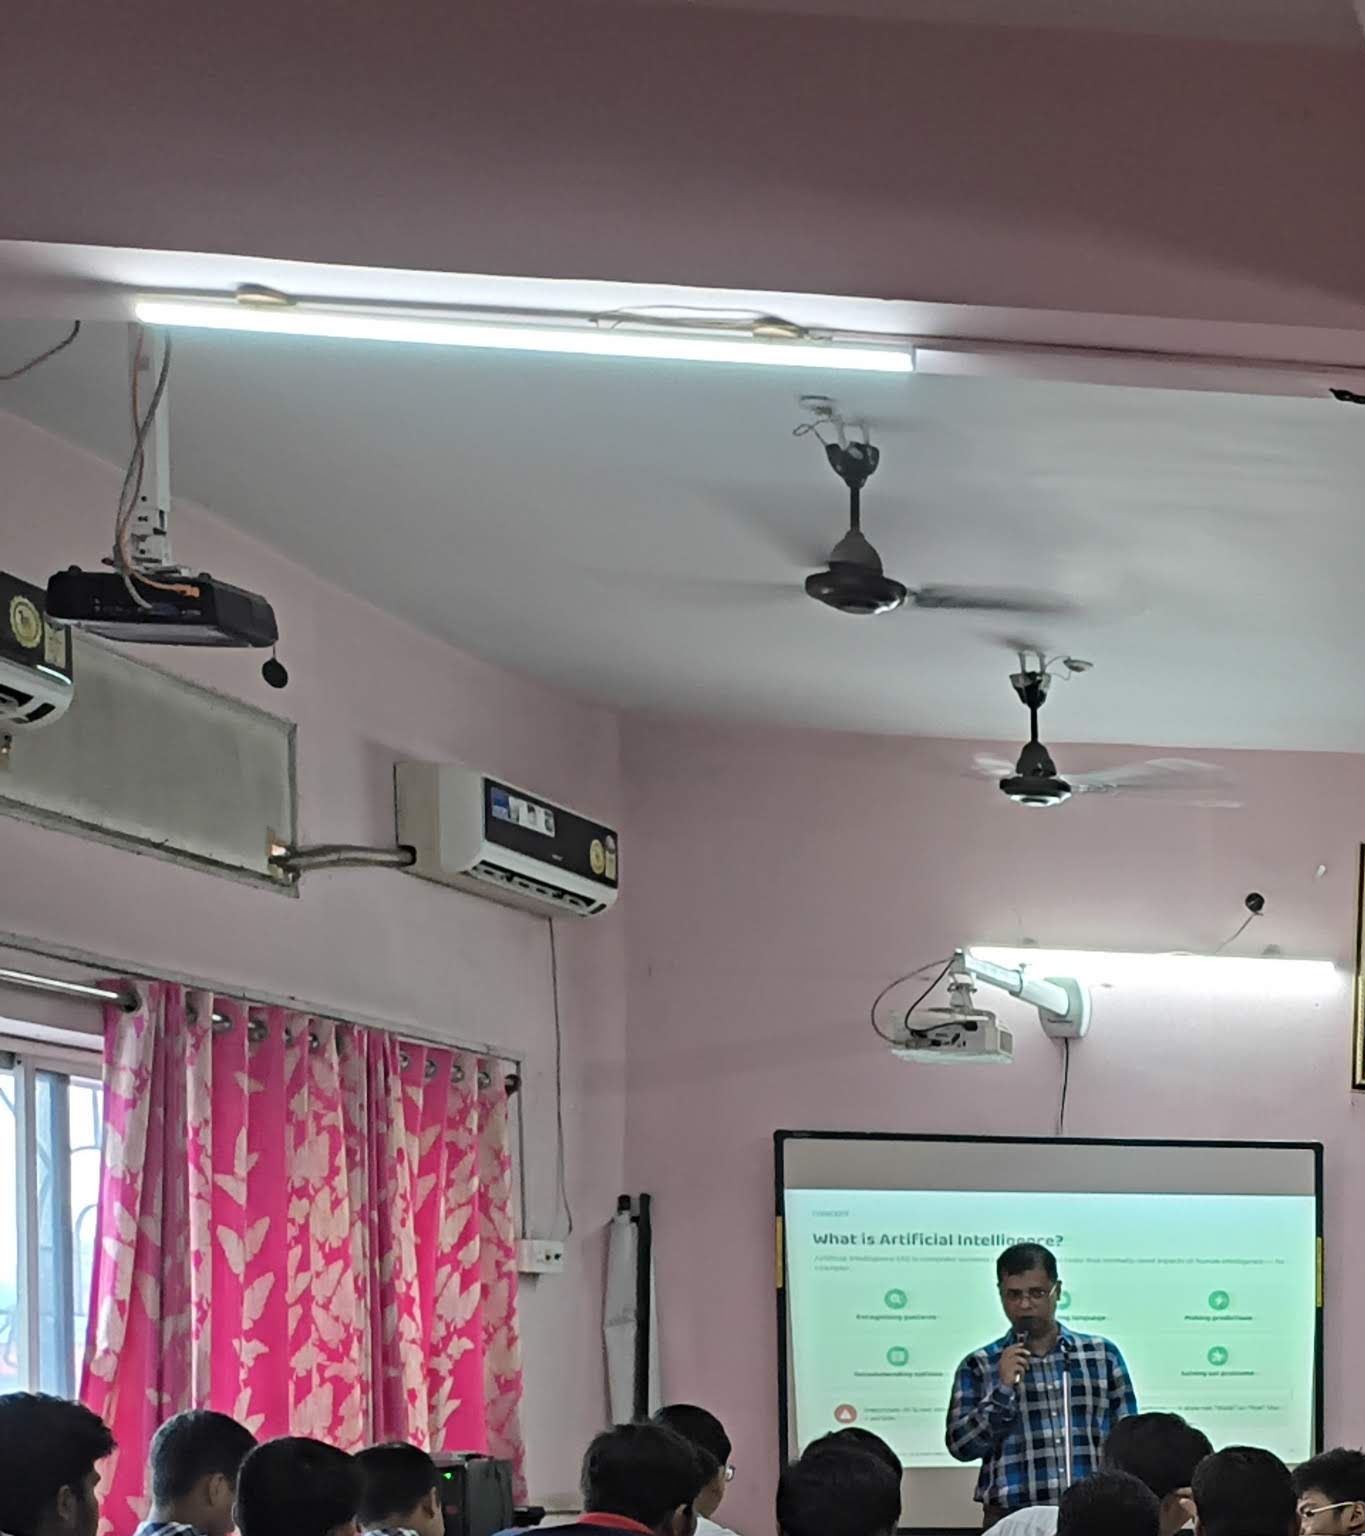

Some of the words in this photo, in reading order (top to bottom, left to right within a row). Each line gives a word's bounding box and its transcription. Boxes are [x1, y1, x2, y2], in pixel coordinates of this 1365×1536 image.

[812, 1232, 857, 1246] What
[861, 1232, 875, 1246] is
[879, 1232, 953, 1247] Artificial
